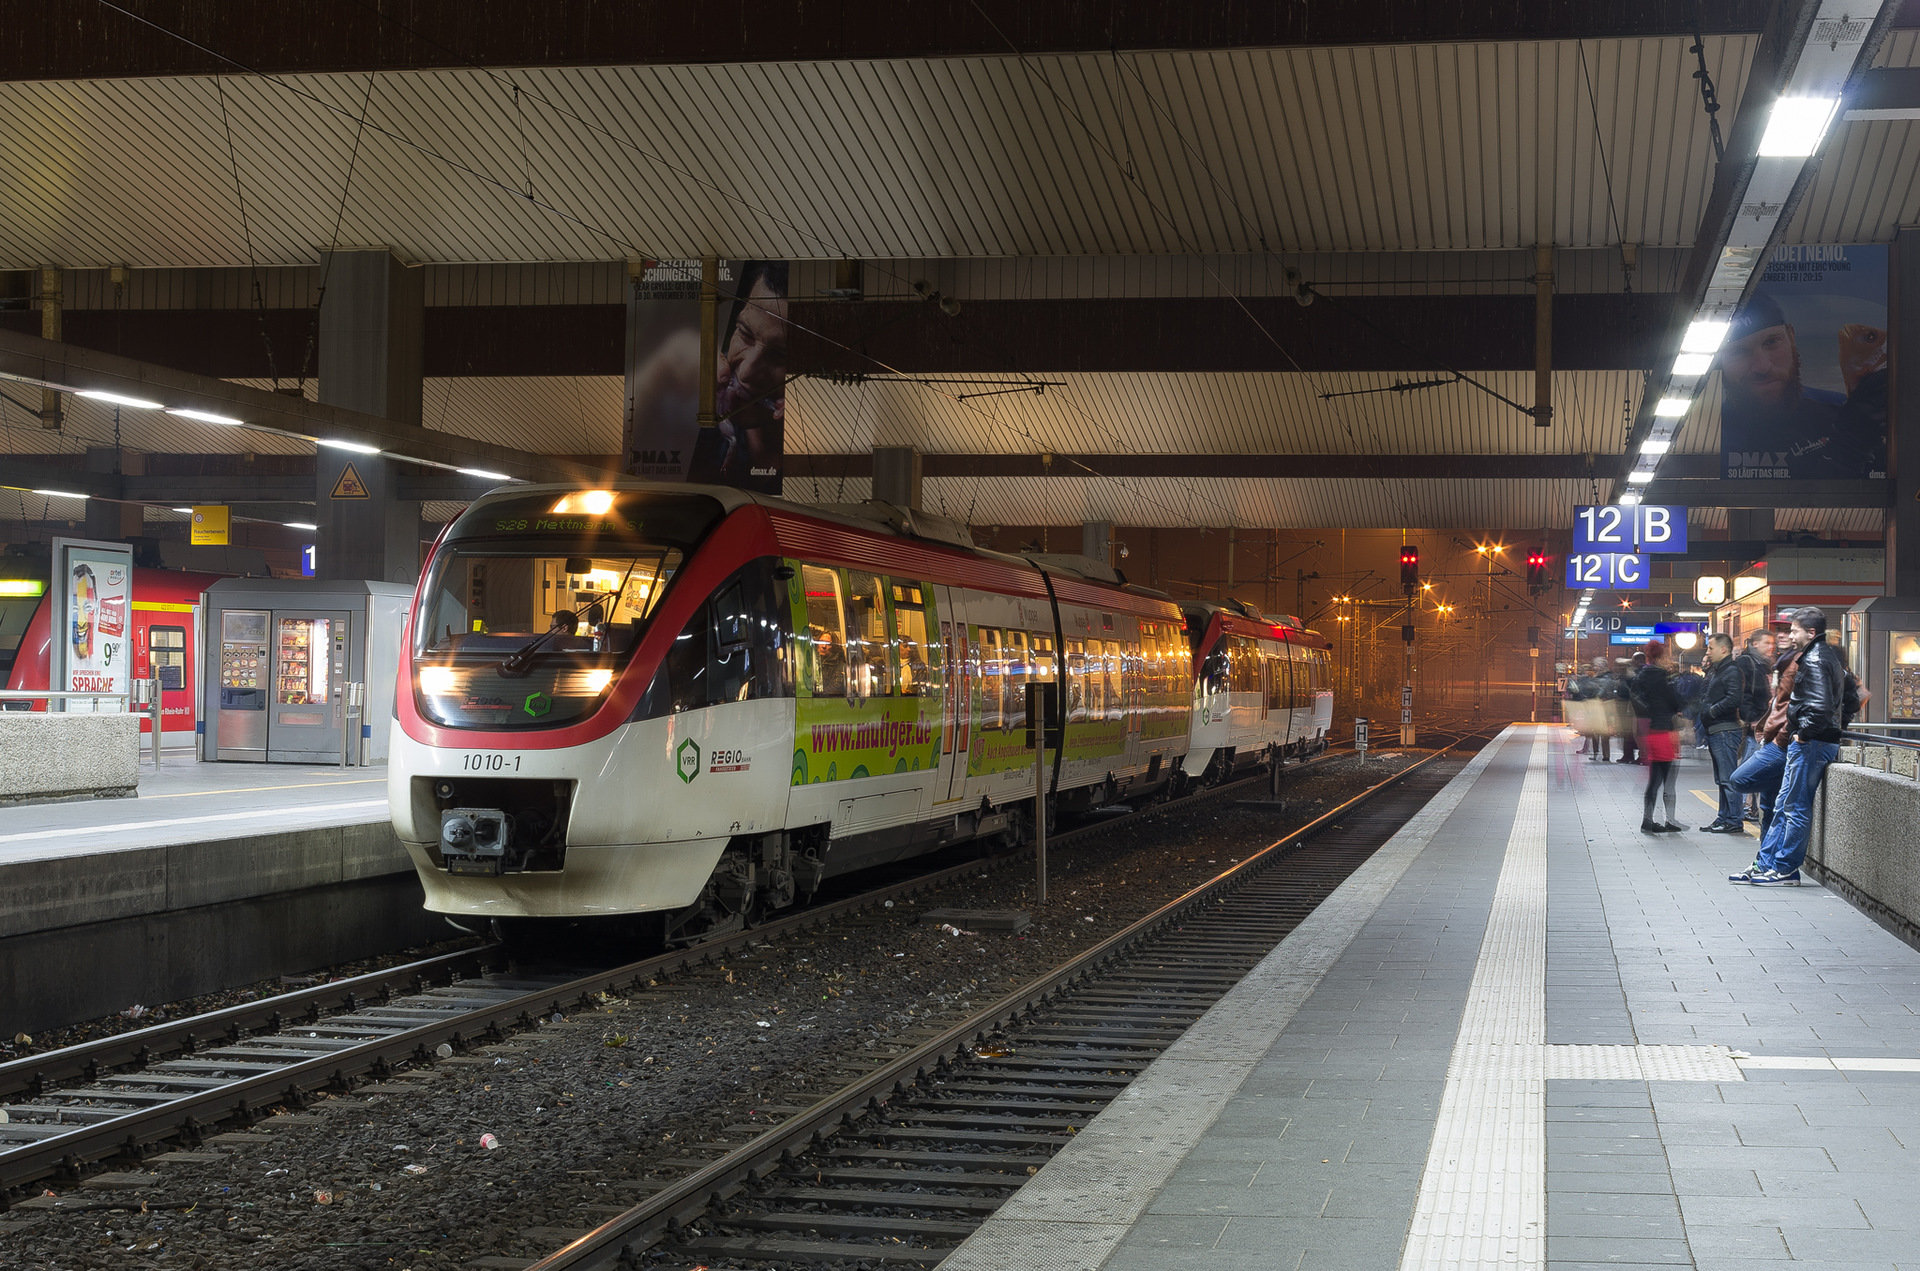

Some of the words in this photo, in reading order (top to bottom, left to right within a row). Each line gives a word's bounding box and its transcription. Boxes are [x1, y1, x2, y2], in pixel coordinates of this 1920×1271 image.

[1807, 245, 1848, 261] NEMO.
[1798, 262, 1811, 272] MIT
[1811, 262, 1827, 272] ERIC
[1828, 262, 1851, 272] YOUNG
[1728, 452, 1789, 467] DMAX
[750, 466, 777, 476] dmax.de
[1728, 469, 1737, 479] SO
[1738, 467, 1758, 479] LÄUFT
[1759, 468, 1772, 478] DAS
[1773, 468, 1791, 478] HIER.
[496, 519, 529, 531] S28
[535, 519, 616, 531] Mettmann
[1580, 506, 1622, 542] 12
[1644, 507, 1671, 542] B
[1570, 554, 1602, 581] 12
[1618, 554, 1640, 583] C
[1588, 616, 1604, 631] 12
[1611, 617, 1622, 631] D
[138, 627, 144, 647] 1
[72, 676, 114, 693] SPRACHE
[1403, 694, 1411, 705] H
[1403, 710, 1411, 722] H
[812, 710, 932, 758] www.mutiger.de
[1356, 726, 1366, 741] H
[464, 754, 521, 771] 1010-1
[682, 756, 696, 766] VRR
[710, 749, 742, 765] REGIO
